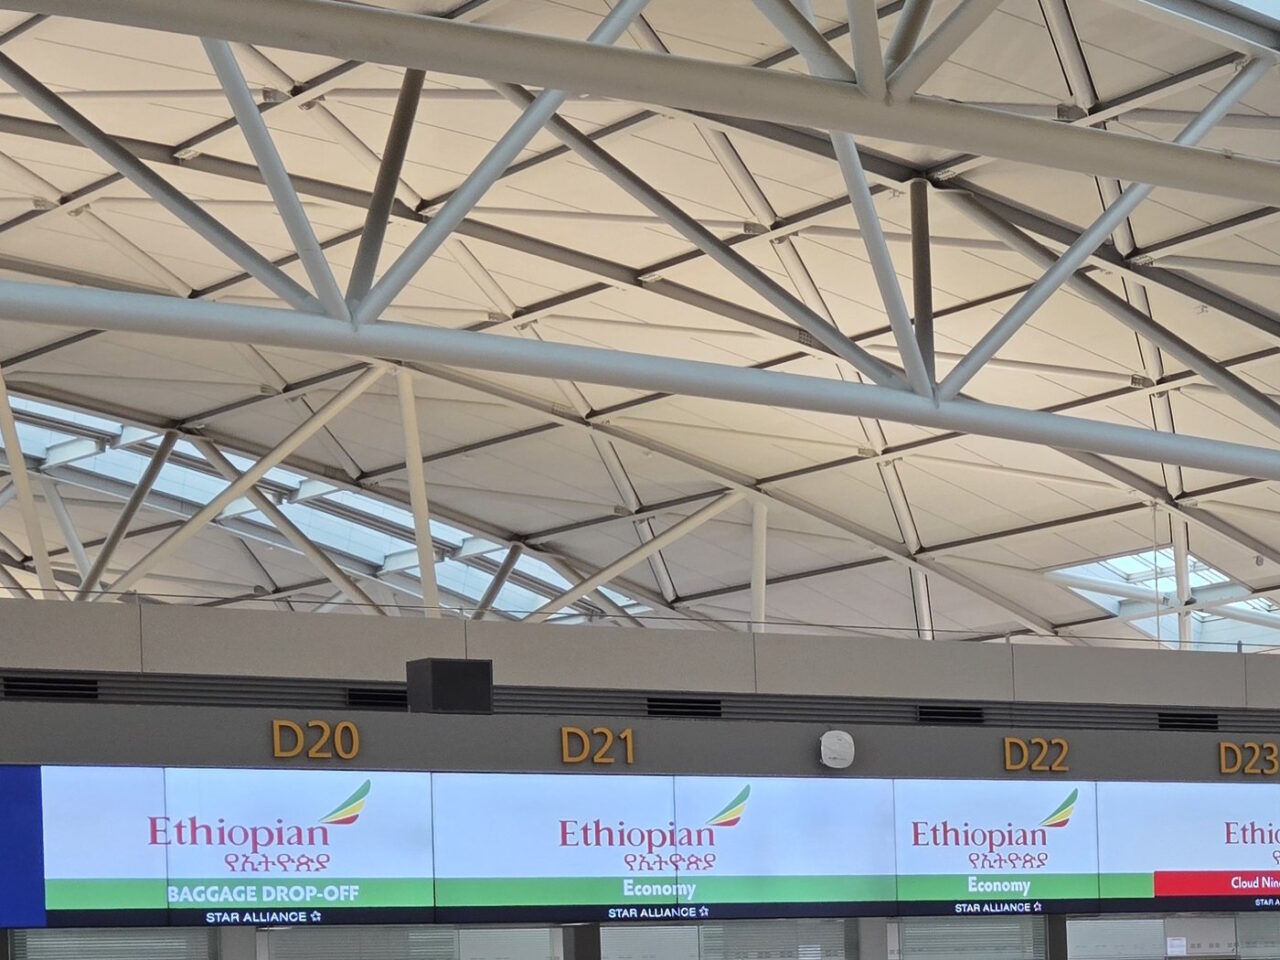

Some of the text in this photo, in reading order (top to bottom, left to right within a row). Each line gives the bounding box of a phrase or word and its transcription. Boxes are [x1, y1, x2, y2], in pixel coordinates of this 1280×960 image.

[272, 719, 360, 759] D20
[560, 726, 635, 765] D21
[1004, 737, 1070, 771] D22
[1218, 742, 1280, 775] D23
[147, 816, 330, 854] Ethiopian
[559, 818, 715, 854] Ethiopian
[911, 820, 1047, 853] Ethiopian
[623, 879, 697, 900] Economy
[968, 876, 1031, 897] Economy
[1231, 876, 1259, 889] Cloud
[168, 885, 359, 903] BAGGAGE DROP-OFF
[1255, 898, 1274, 906] STAR
[206, 911, 307, 923] STAR ALLIANCE
[608, 907, 696, 918] STAR ALLIANCE
[955, 902, 1031, 913] STAR ALLIANCE
